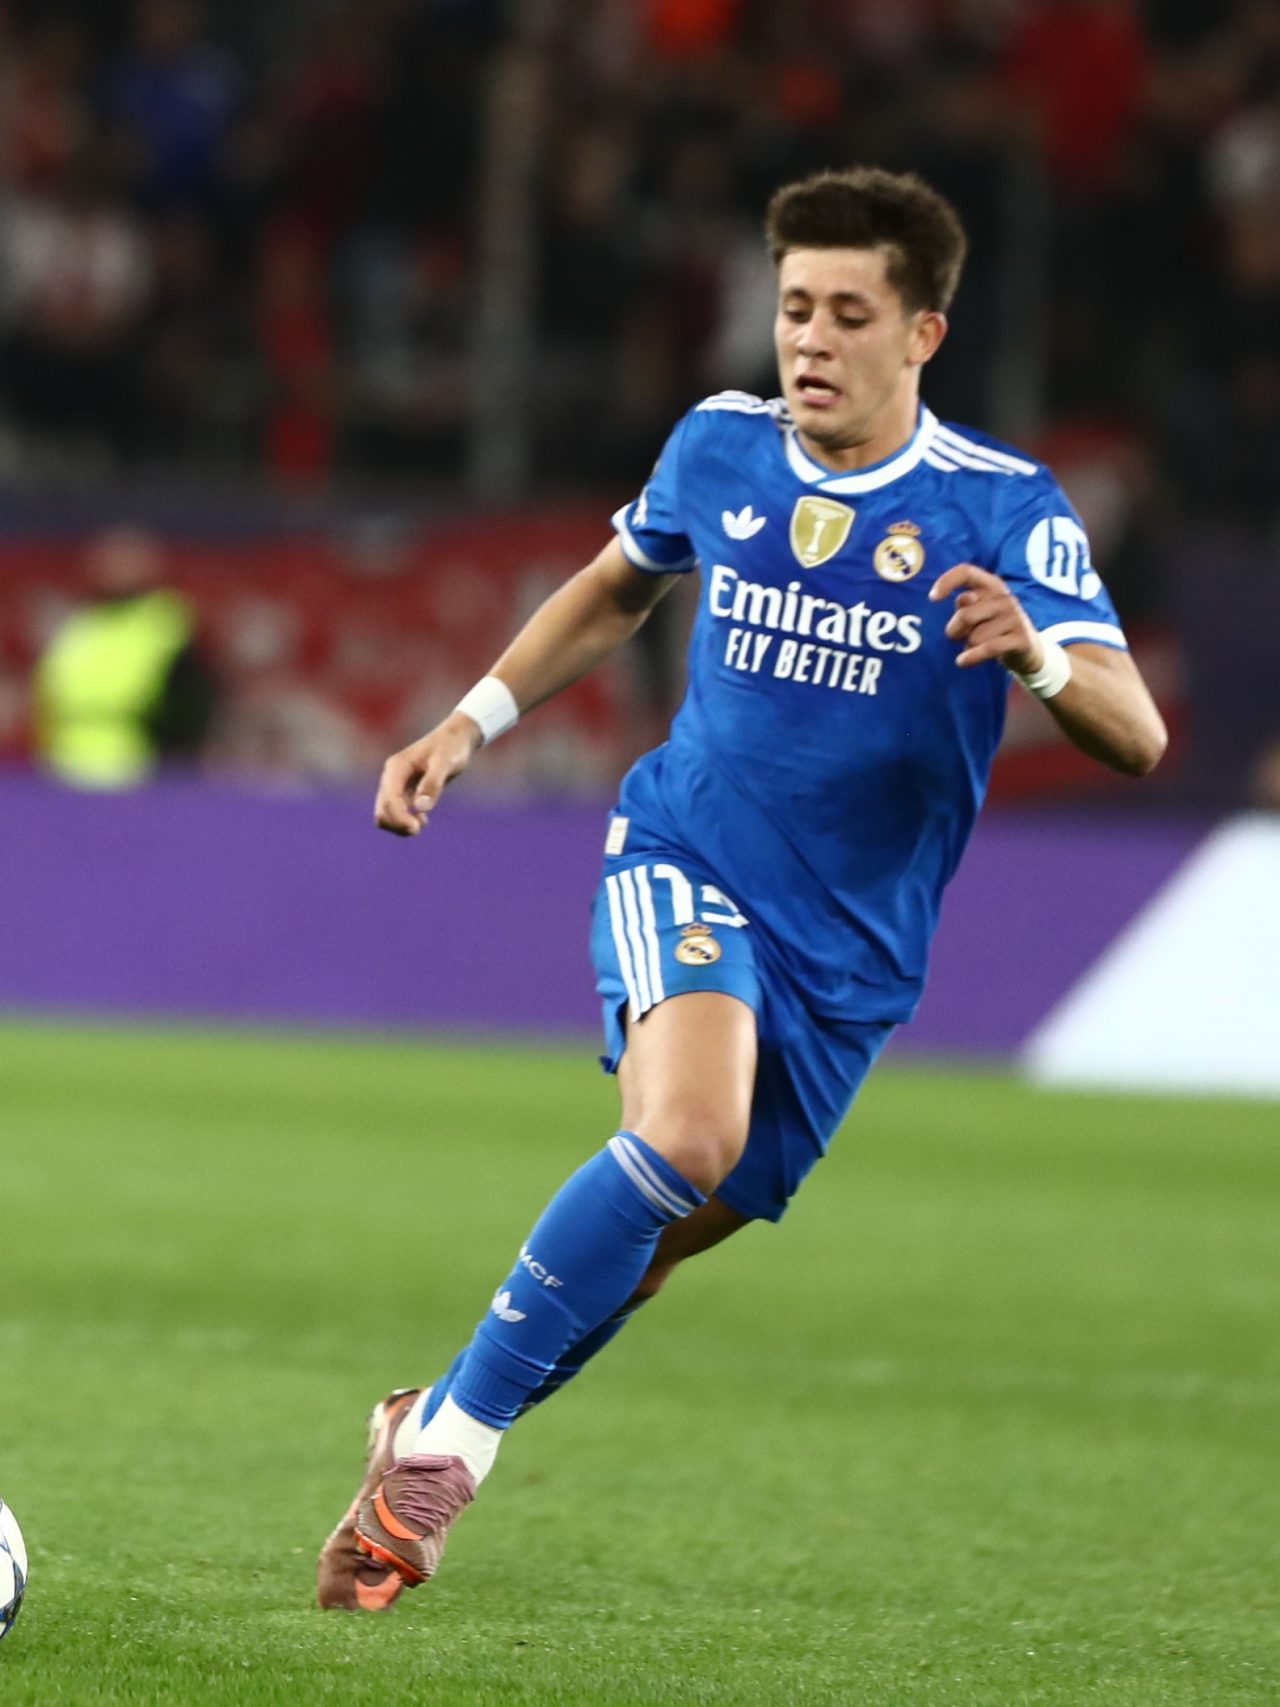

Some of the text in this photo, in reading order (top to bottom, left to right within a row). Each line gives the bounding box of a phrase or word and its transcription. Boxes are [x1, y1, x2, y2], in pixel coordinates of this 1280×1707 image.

[709, 564, 923, 654] Emirates
[724, 628, 883, 696] FLY BETTER
